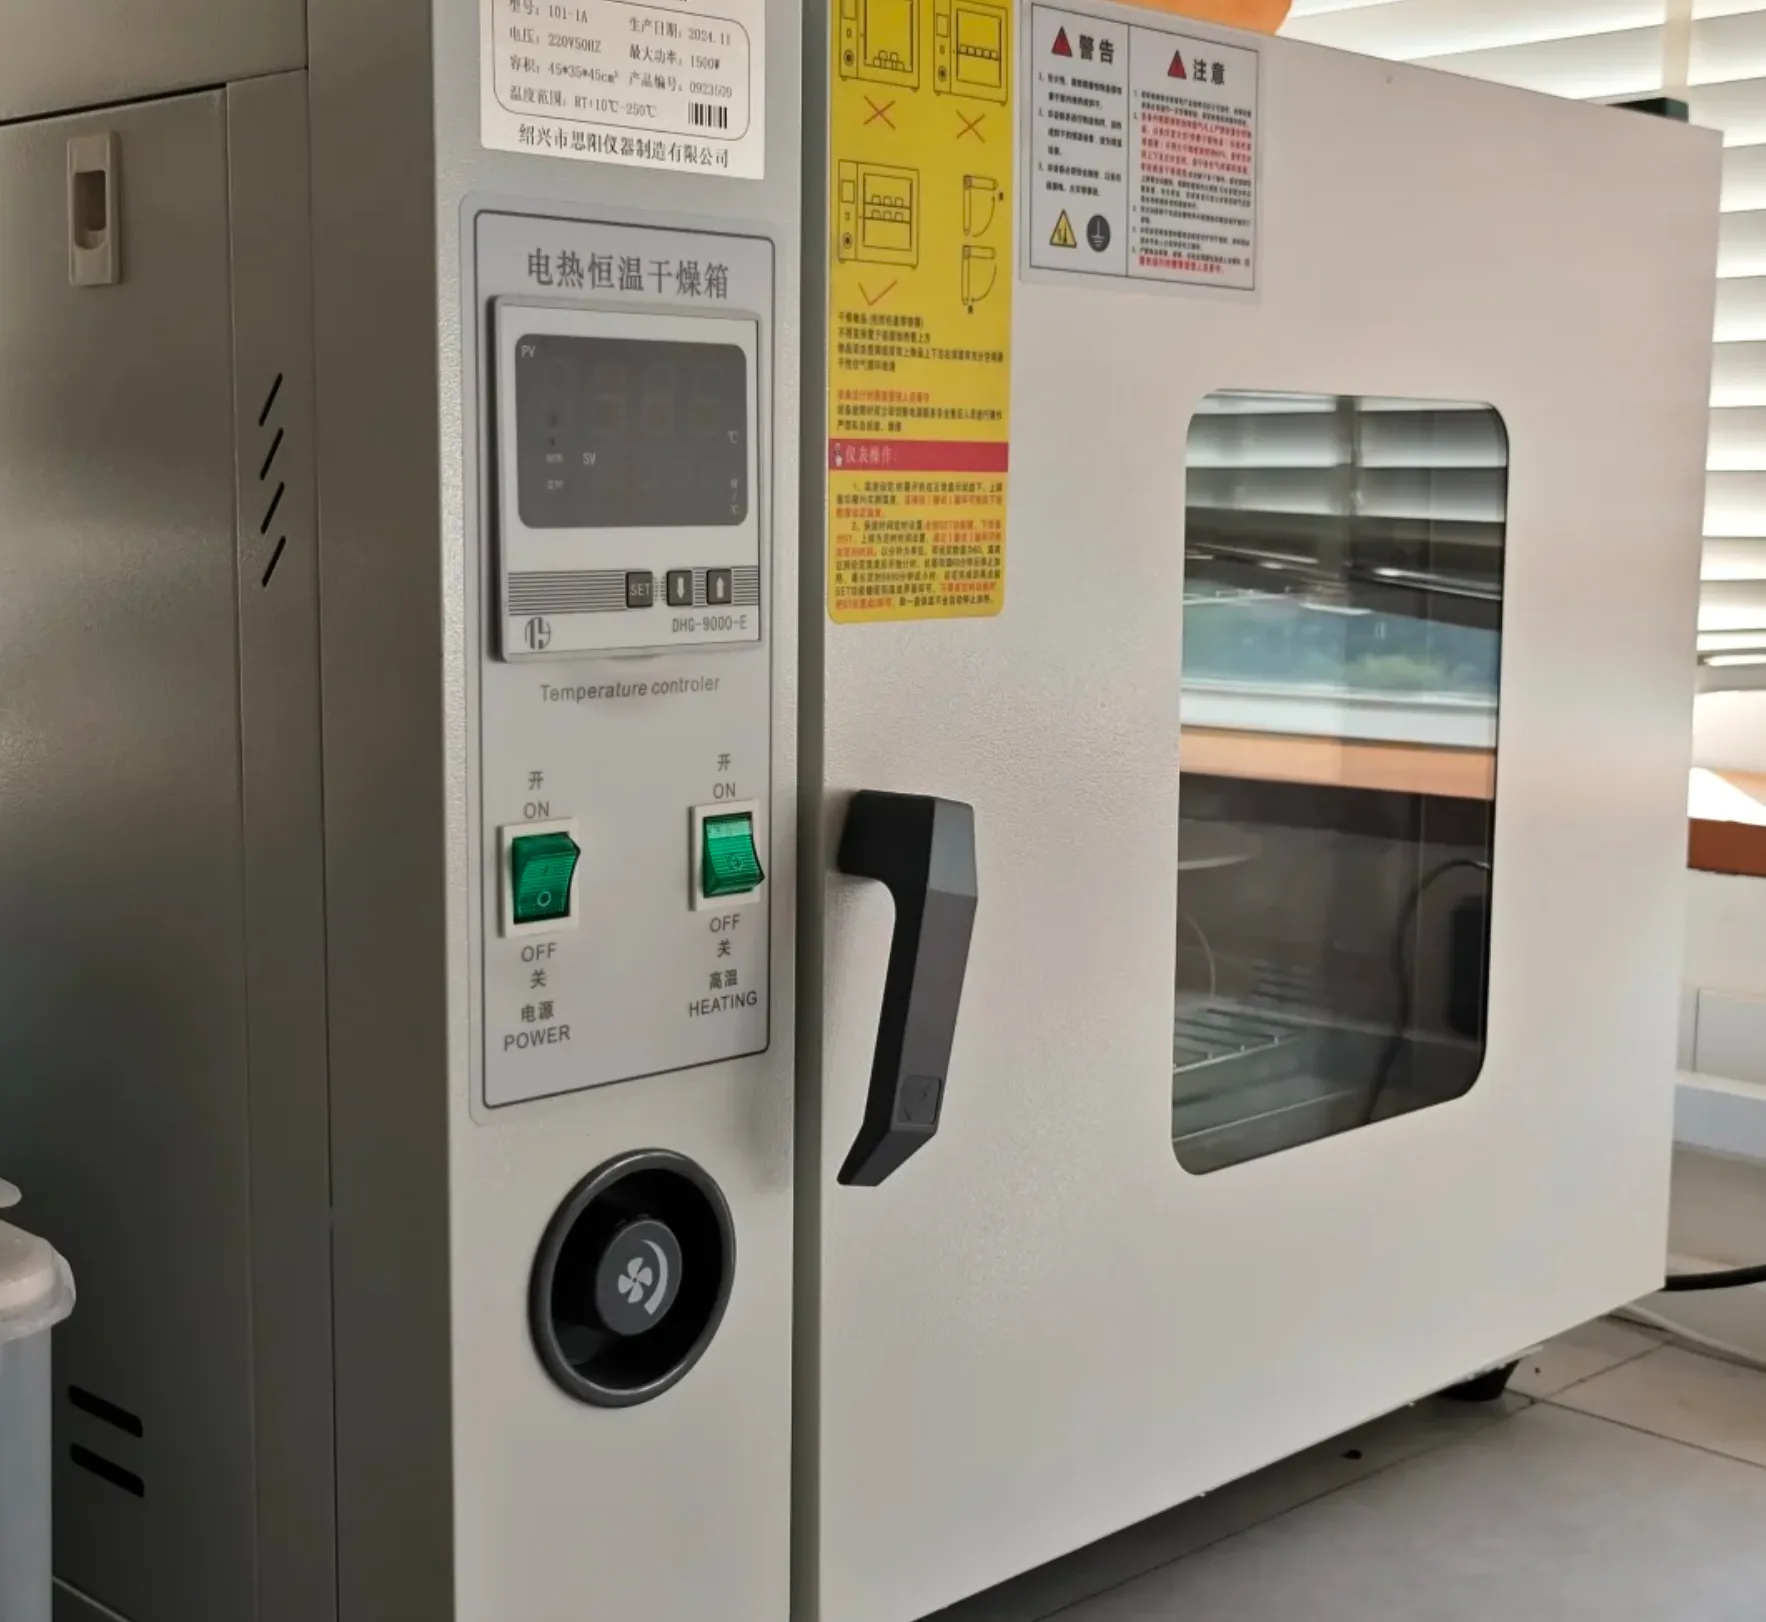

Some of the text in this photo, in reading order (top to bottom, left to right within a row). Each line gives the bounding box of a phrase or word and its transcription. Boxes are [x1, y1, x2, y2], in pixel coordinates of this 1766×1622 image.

[549, 5, 588, 23] 101-1A
[548, 33, 602, 54] 220V50HZ
[1079, 34, 1115, 65] 警告
[691, 55, 720, 70] 1500W
[1192, 59, 1226, 86] 注意
[518, 123, 729, 169] 绍兴市思阳仪器制造有限公司
[527, 247, 730, 300] 电热恒温干燥箱
[521, 344, 536, 359] PV
[582, 451, 597, 467] SV
[629, 582, 652, 598] SET
[671, 614, 748, 634] DHG-9000-E
[540, 676, 721, 705] Temperature controler
[717, 753, 732, 772] 开
[527, 770, 545, 791] 开
[713, 782, 736, 799] ON
[523, 801, 550, 819] ON
[709, 914, 741, 933] OFF
[521, 942, 557, 963] OFF
[717, 938, 732, 957] 关
[530, 968, 548, 990] 关
[709, 969, 739, 991] 高温
[521, 1000, 555, 1024] 电源
[688, 990, 758, 1018] HEATING
[504, 1024, 571, 1053] POWER
